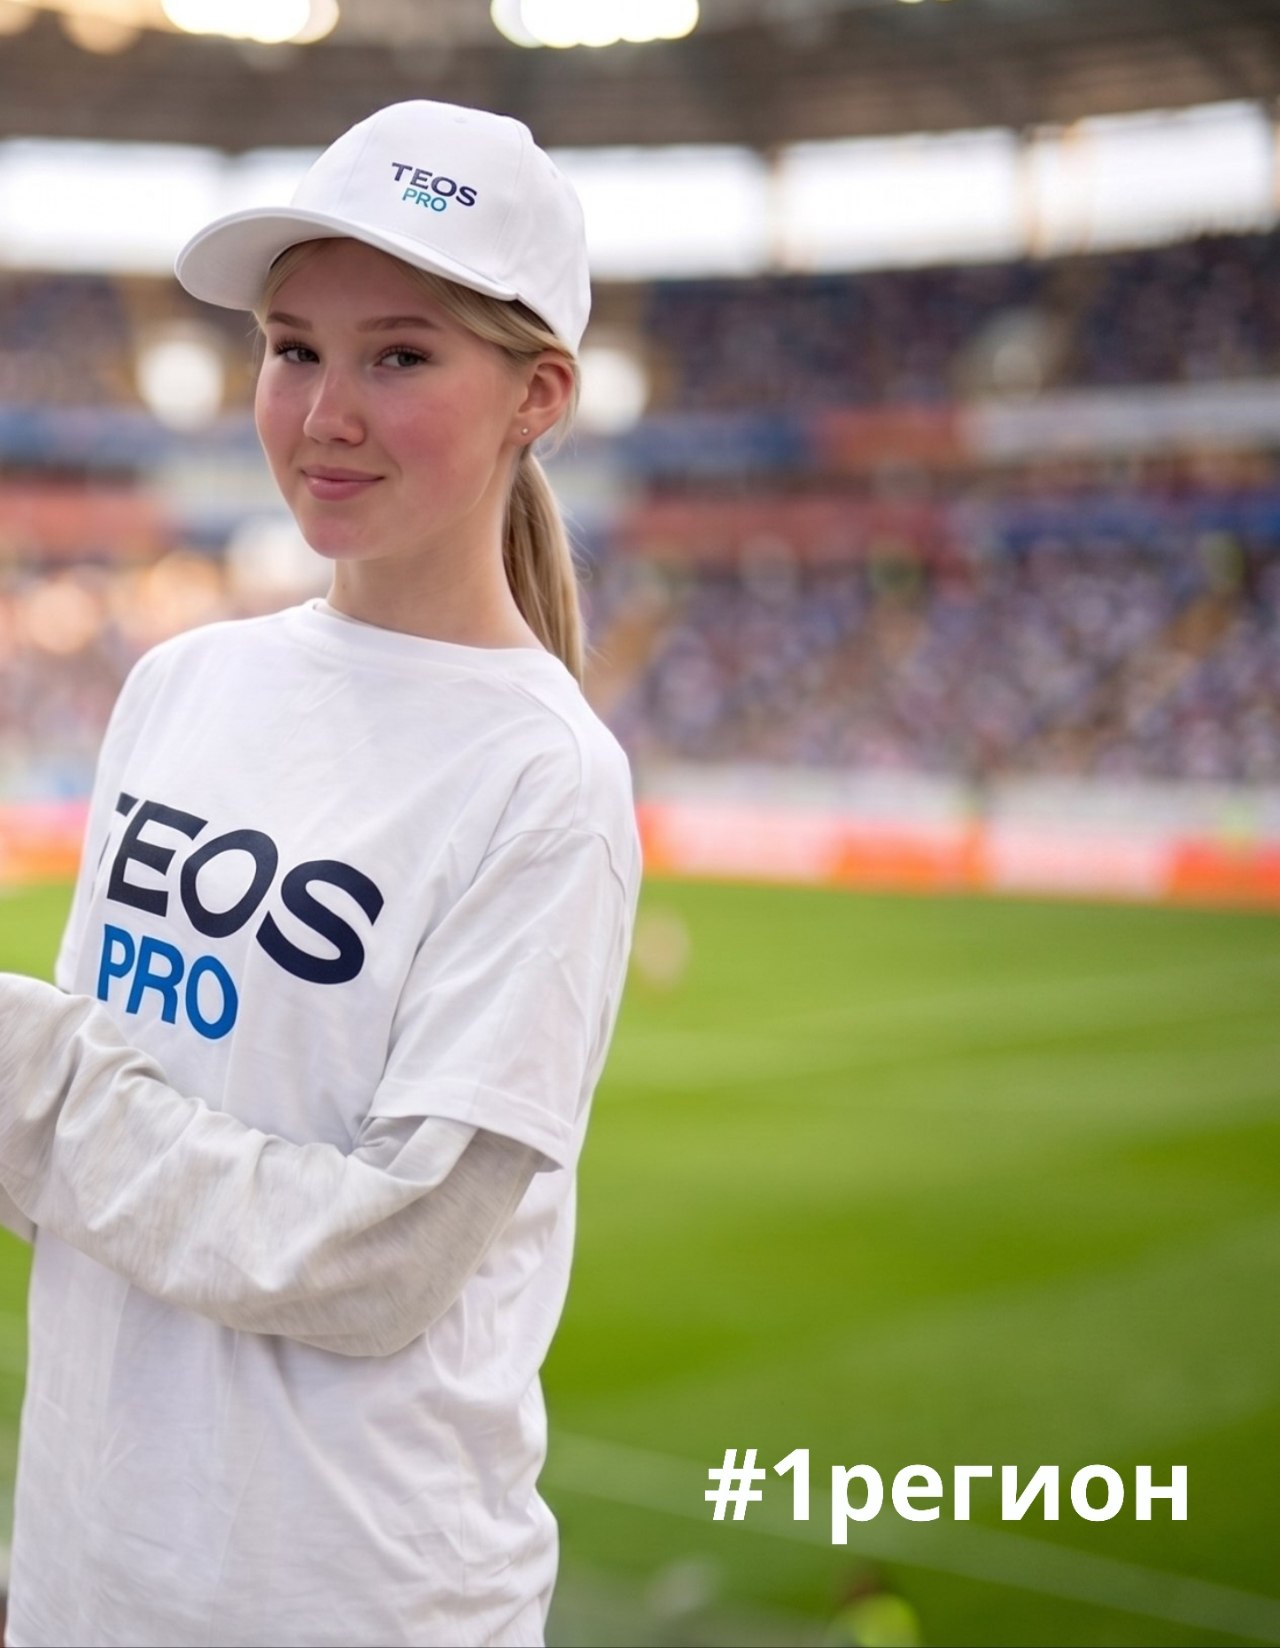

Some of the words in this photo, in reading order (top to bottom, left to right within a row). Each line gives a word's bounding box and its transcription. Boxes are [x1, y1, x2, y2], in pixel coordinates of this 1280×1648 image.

[391, 161, 478, 207] TEOS
[402, 187, 447, 212] PRO
[97, 923, 239, 1040] PRO
